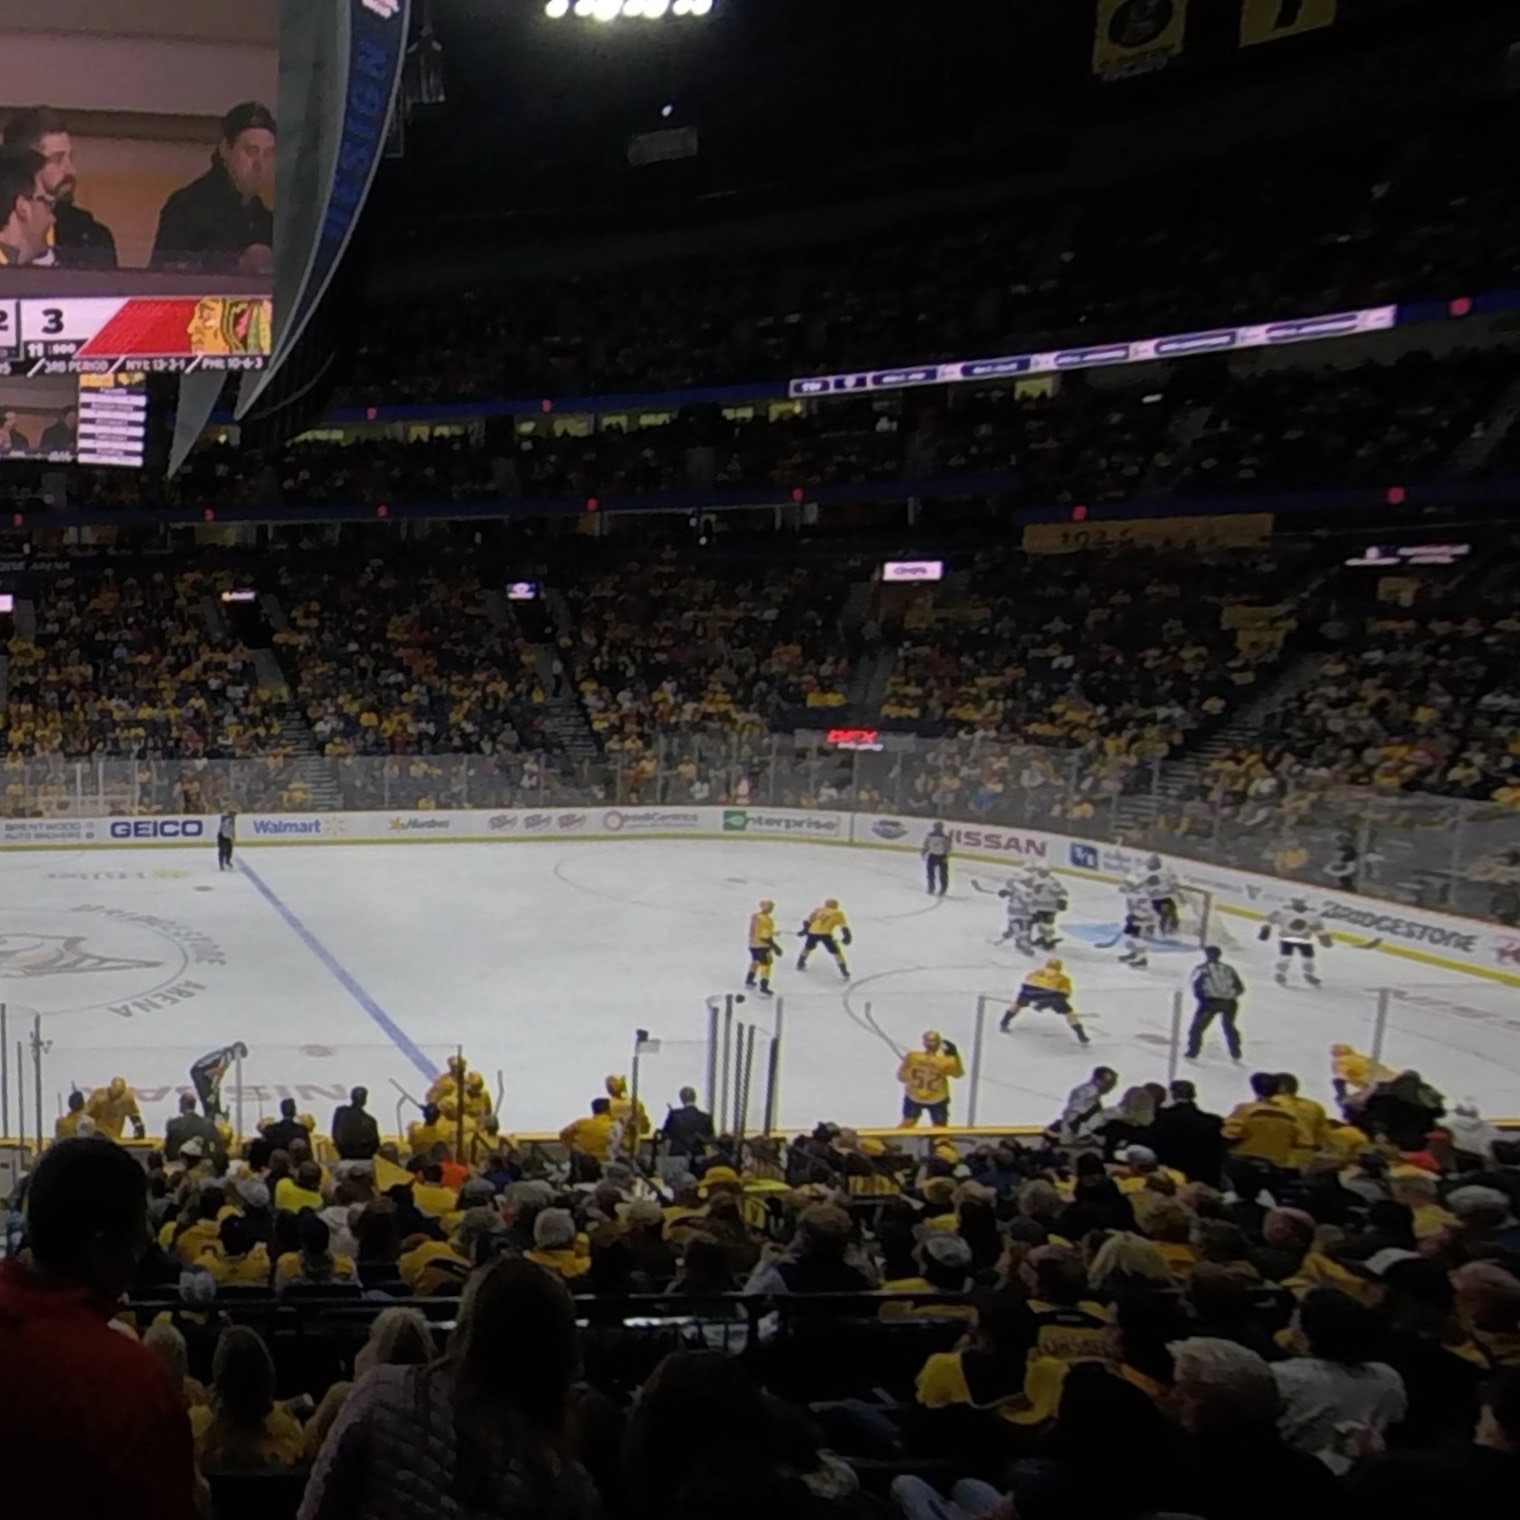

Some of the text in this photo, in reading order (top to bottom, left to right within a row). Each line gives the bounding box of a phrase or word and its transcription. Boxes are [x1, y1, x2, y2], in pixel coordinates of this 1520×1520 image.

[41, 309, 64, 334] 3
[110, 820, 203, 838] GEICO
[254, 820, 320, 834] Walmart
[948, 829, 1048, 857] ISSAN
[1321, 900, 1477, 952] BRIDGESTONE
[107, 980, 207, 1018] ARENA
[911, 1067, 943, 1092] 52
